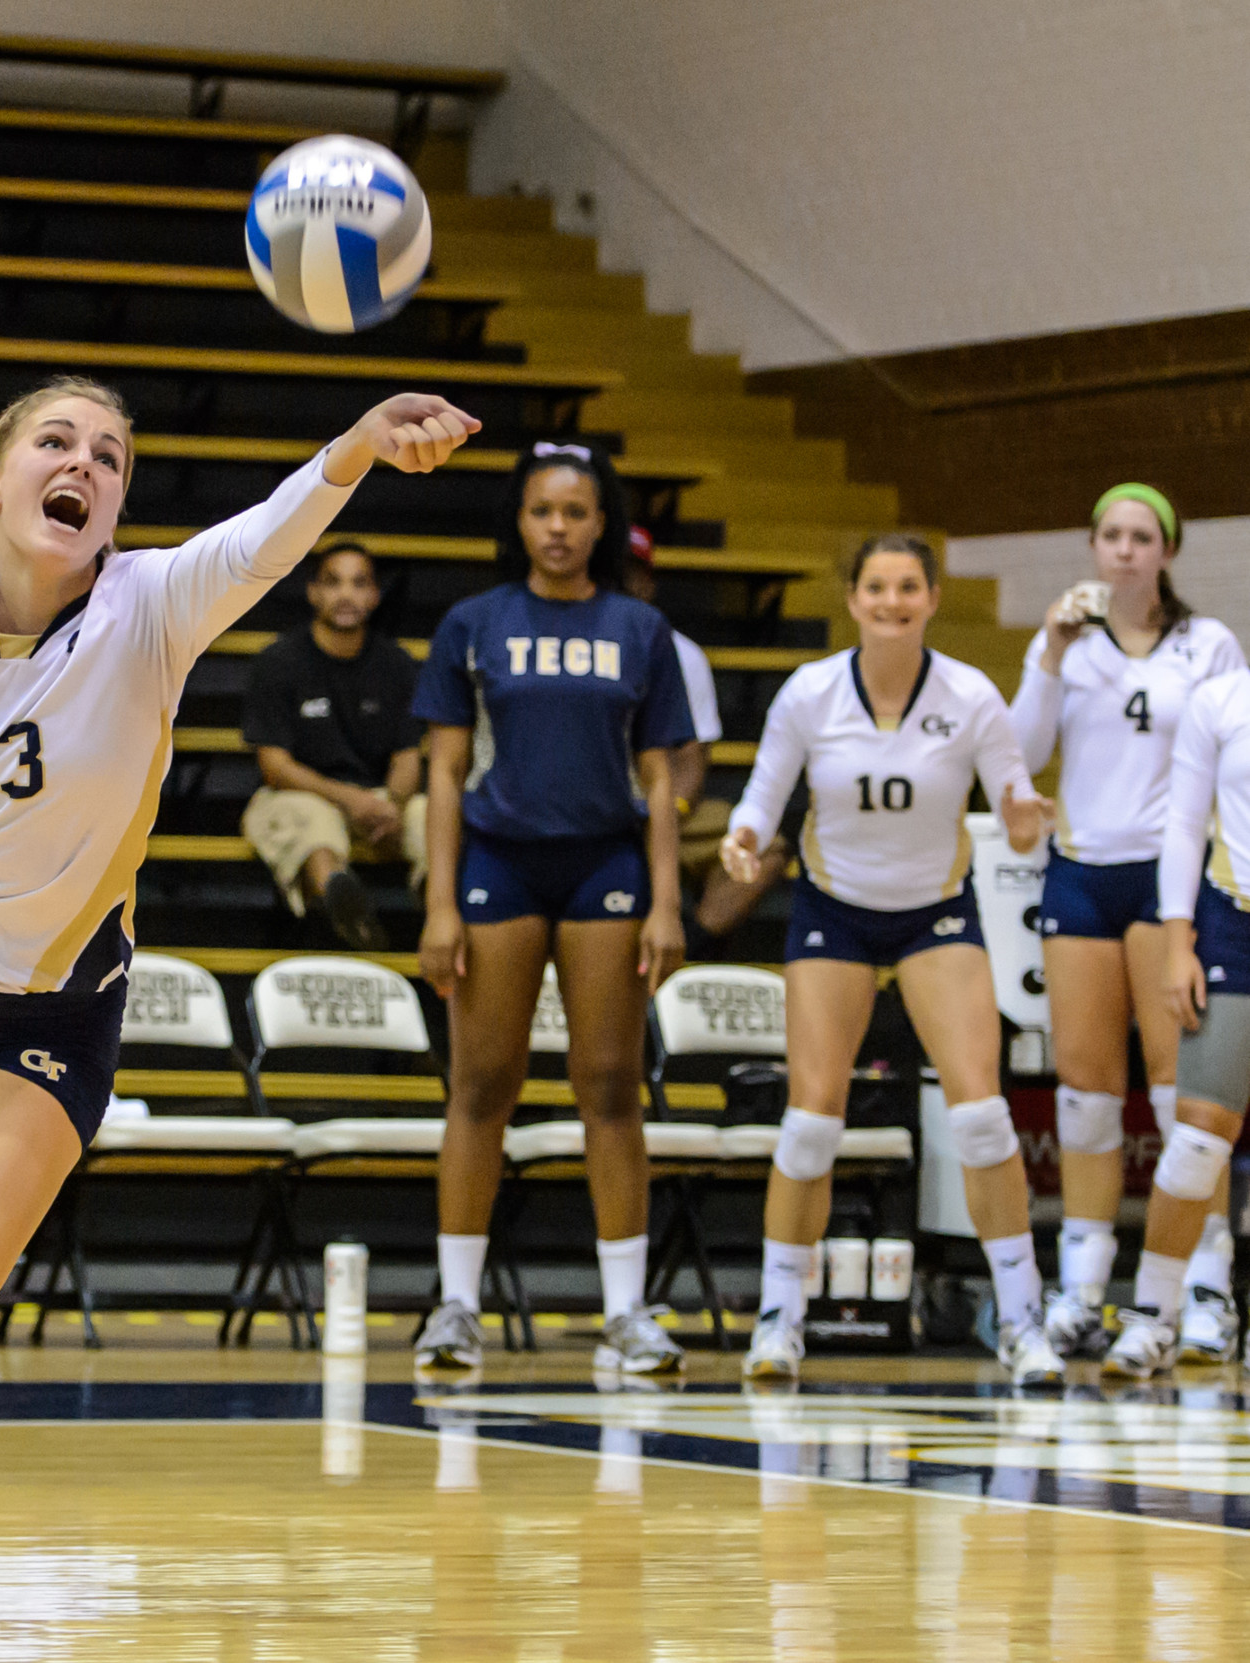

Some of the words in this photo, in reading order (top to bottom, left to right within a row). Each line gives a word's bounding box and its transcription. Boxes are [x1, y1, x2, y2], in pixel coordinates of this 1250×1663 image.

[506, 637, 621, 681] TECH
[1125, 690, 1151, 732] 4
[856, 774, 914, 812] 10
[274, 973, 406, 998] GEORGIA
[678, 982, 785, 1003] GEORGI
[128, 998, 188, 1024] ECH
[302, 1000, 386, 1028] TECH
[20, 1049, 67, 1082] GT
